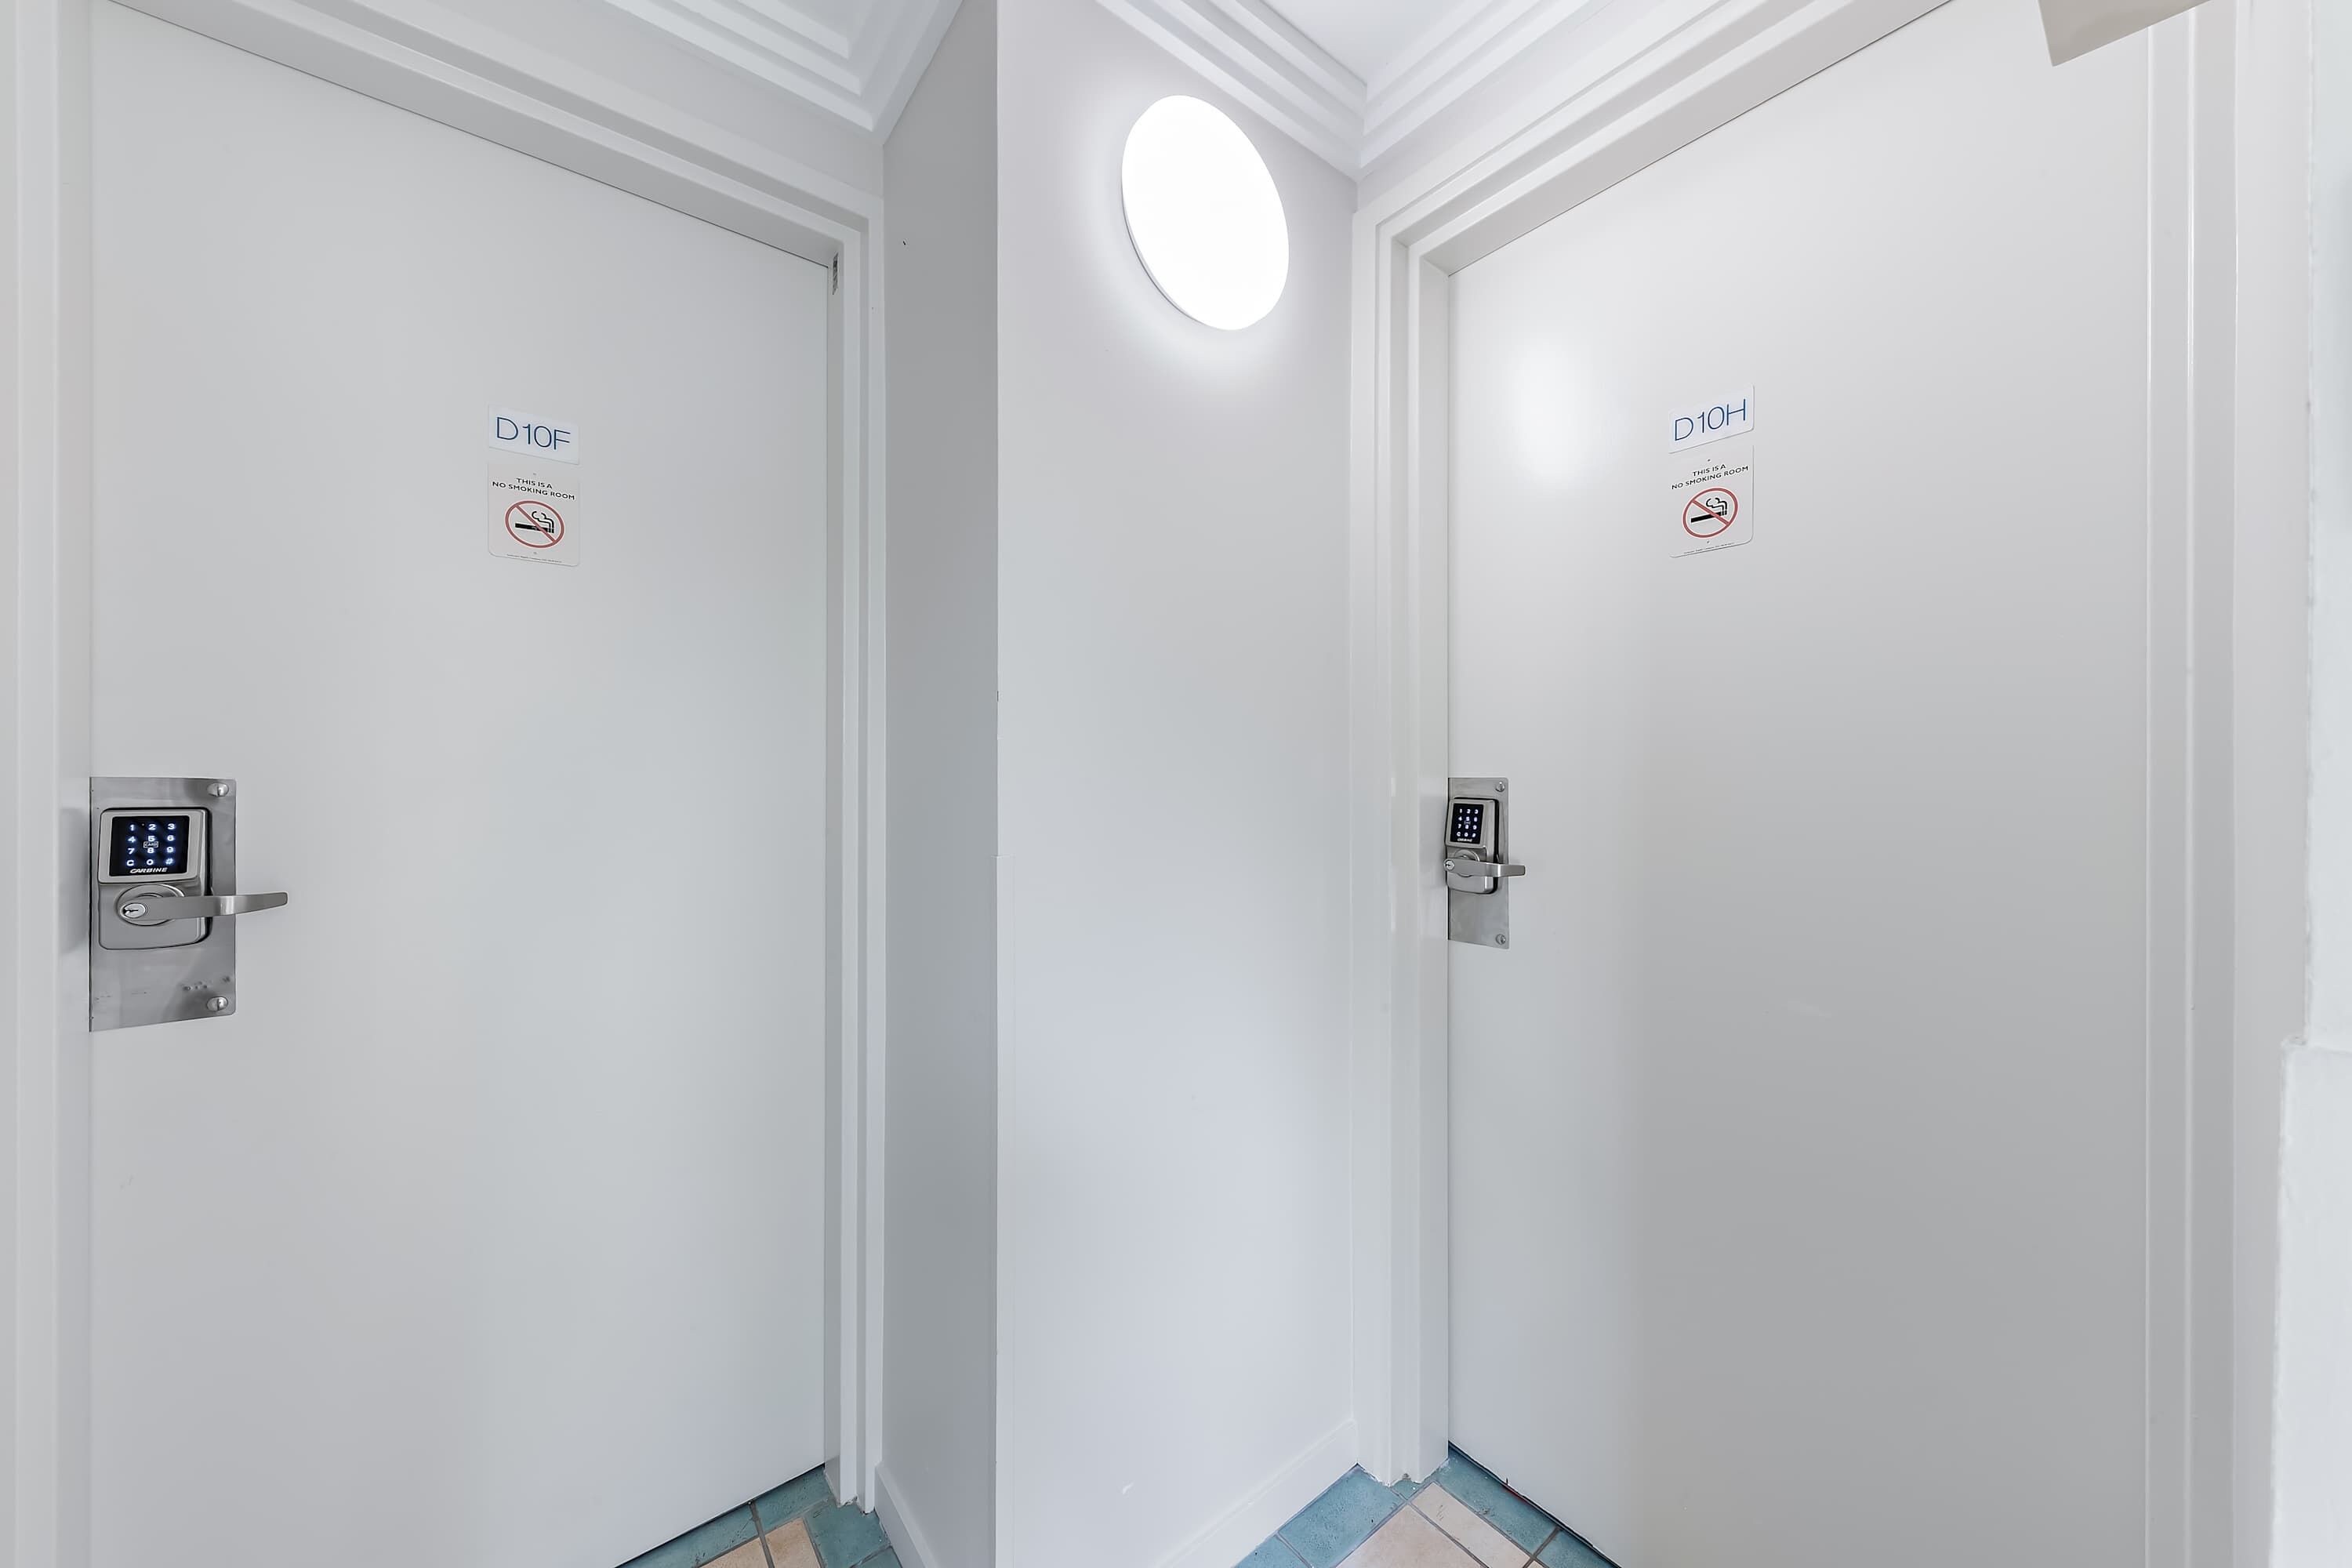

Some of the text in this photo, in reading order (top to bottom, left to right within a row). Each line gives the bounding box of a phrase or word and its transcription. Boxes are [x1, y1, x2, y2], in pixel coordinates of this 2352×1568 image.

[1675, 398, 1746, 441] D10H
[496, 416, 572, 450] D10F
[516, 477, 535, 486] THIS
[1686, 473, 1722, 486] SMOKING
[1724, 466, 1748, 476] ROOM
[508, 484, 548, 495] SMOKING
[550, 491, 575, 500] ROOM
